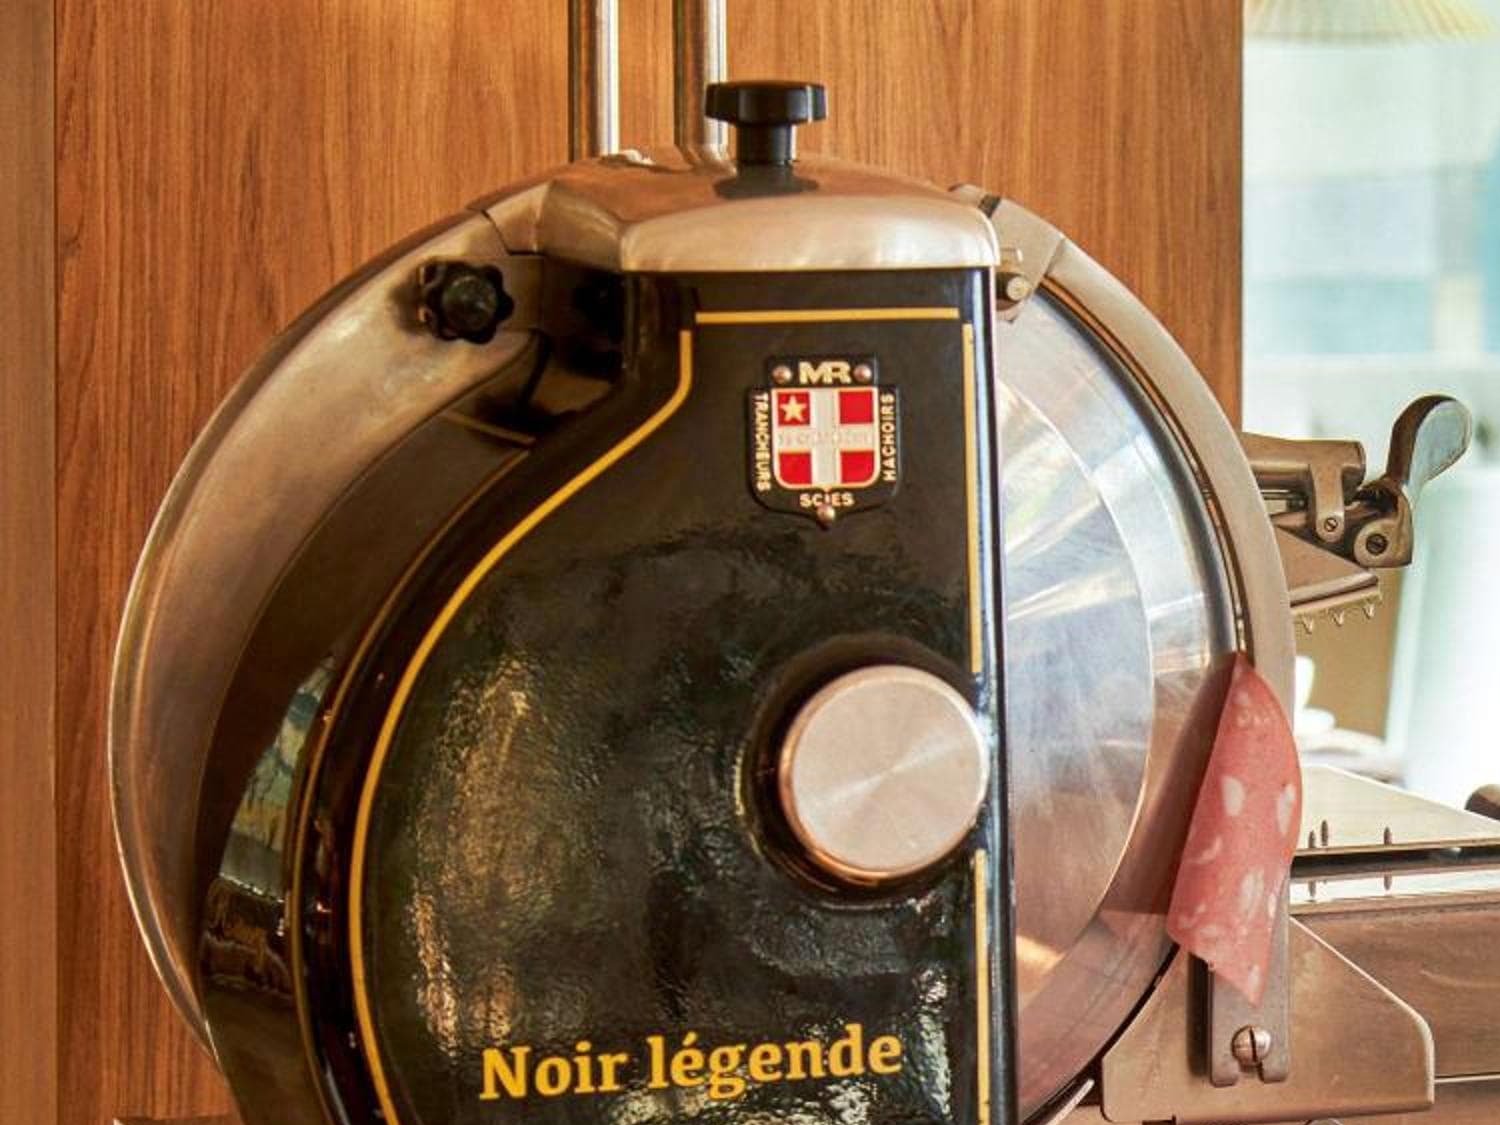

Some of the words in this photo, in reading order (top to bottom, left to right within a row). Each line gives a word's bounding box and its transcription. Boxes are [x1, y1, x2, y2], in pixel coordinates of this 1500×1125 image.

[799, 361, 852, 384] MR
[880, 394, 897, 481] HACHOIRS
[799, 493, 855, 508] SCIES
[480, 1040, 629, 1100] Noir
[645, 1023, 903, 1100] légende
